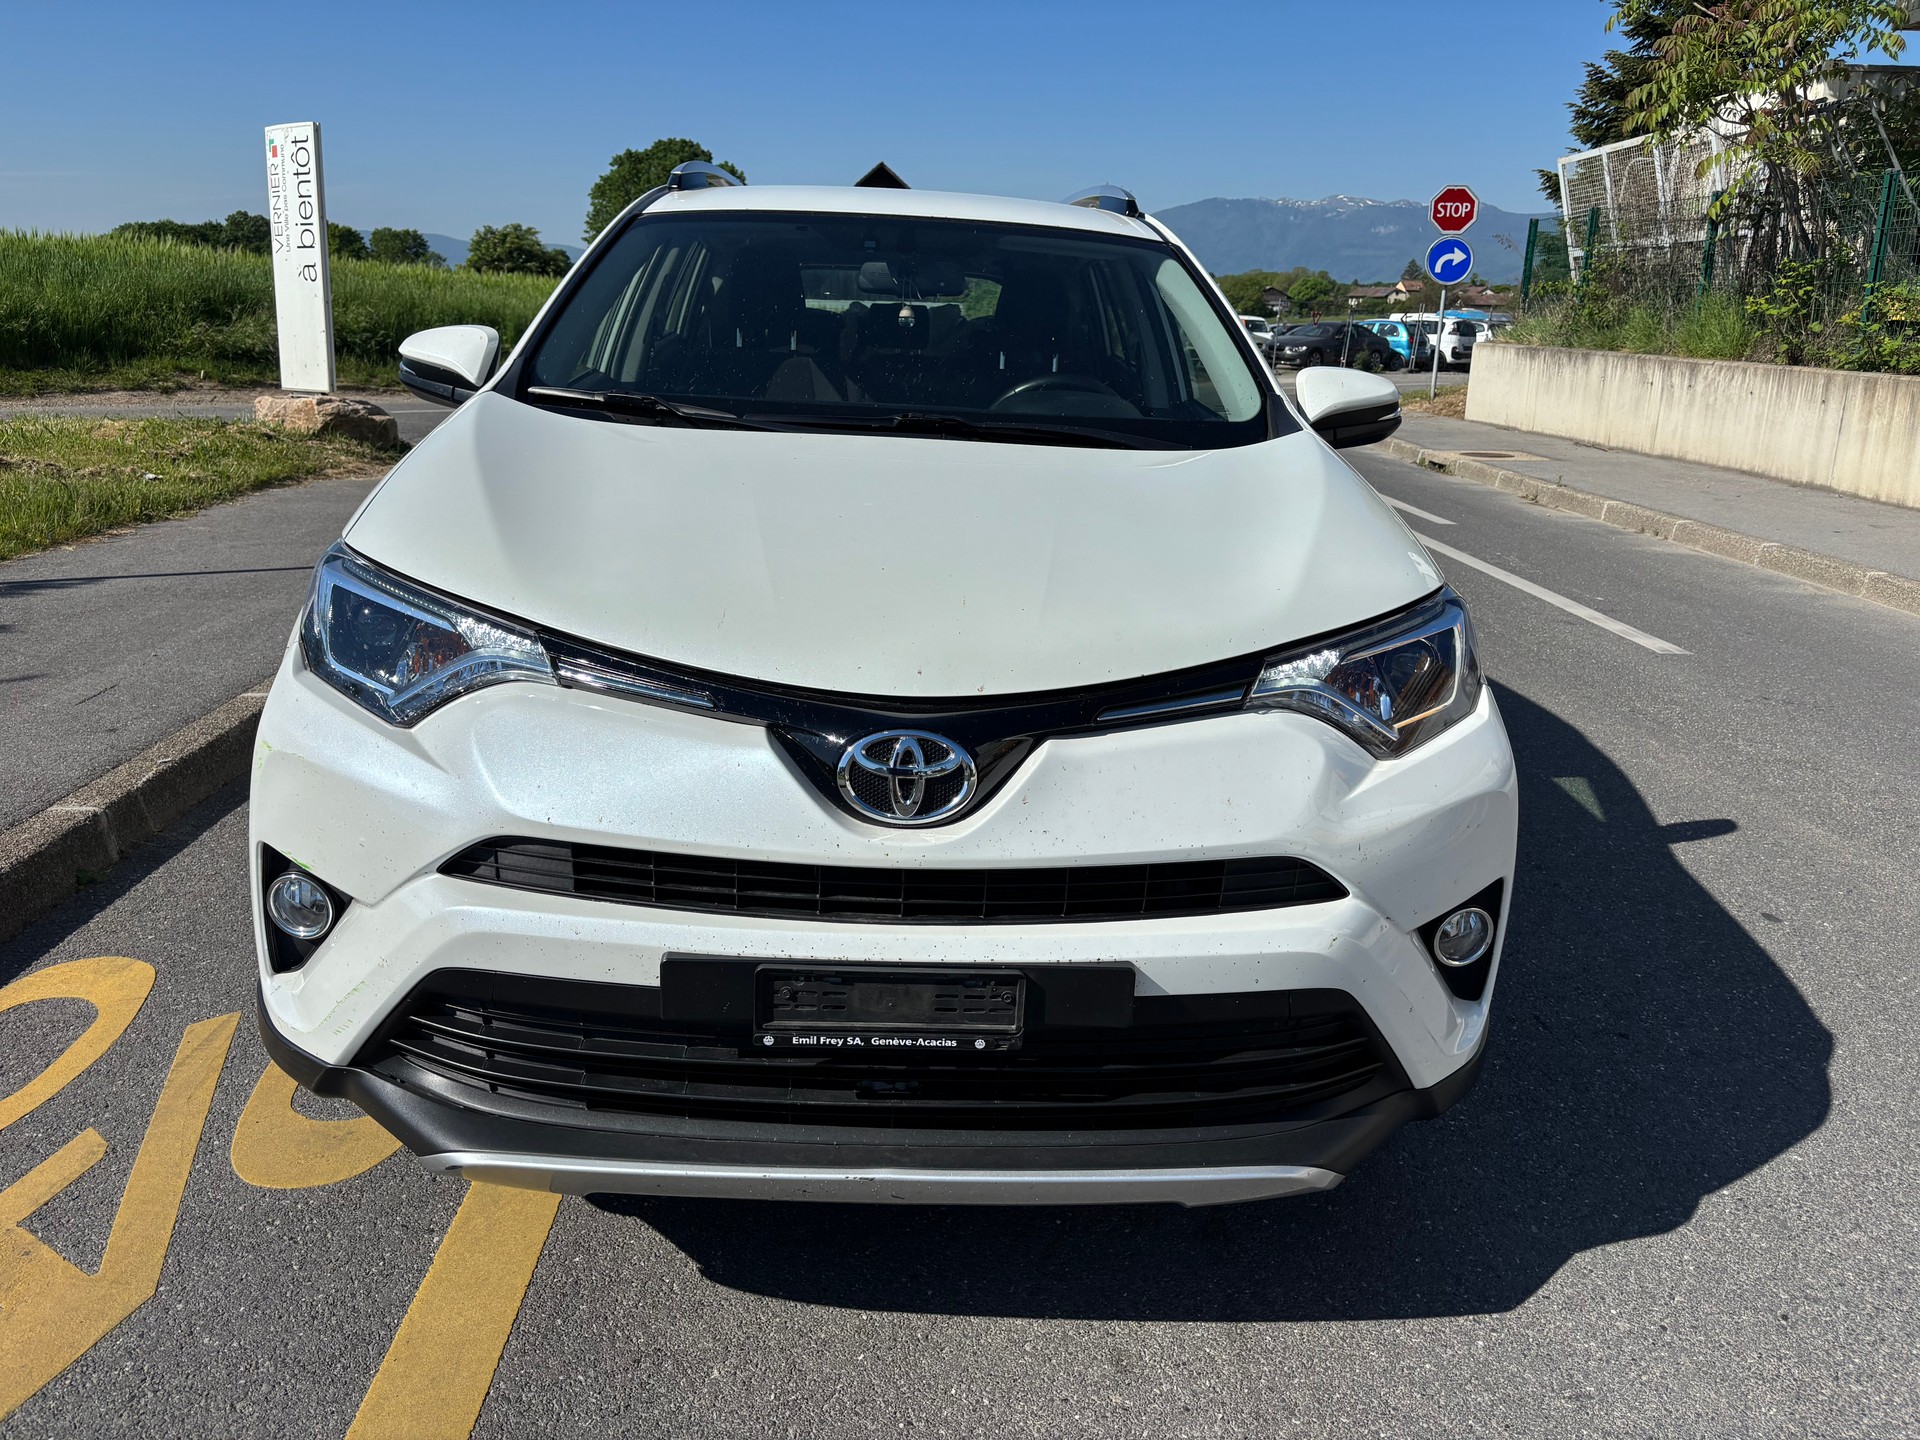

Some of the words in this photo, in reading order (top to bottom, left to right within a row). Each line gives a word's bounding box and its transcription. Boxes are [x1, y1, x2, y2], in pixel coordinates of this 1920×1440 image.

[280, 143, 288, 193] Commune
[270, 163, 284, 254] VERNIER
[290, 135, 316, 249] bientôt
[1436, 202, 1471, 218] STOP
[298, 262, 318, 283] à
[792, 1035, 817, 1045] Emil
[820, 1036, 844, 1047] Frey
[846, 1037, 865, 1046] SA,
[871, 1037, 957, 1047] Genève-Acacias
